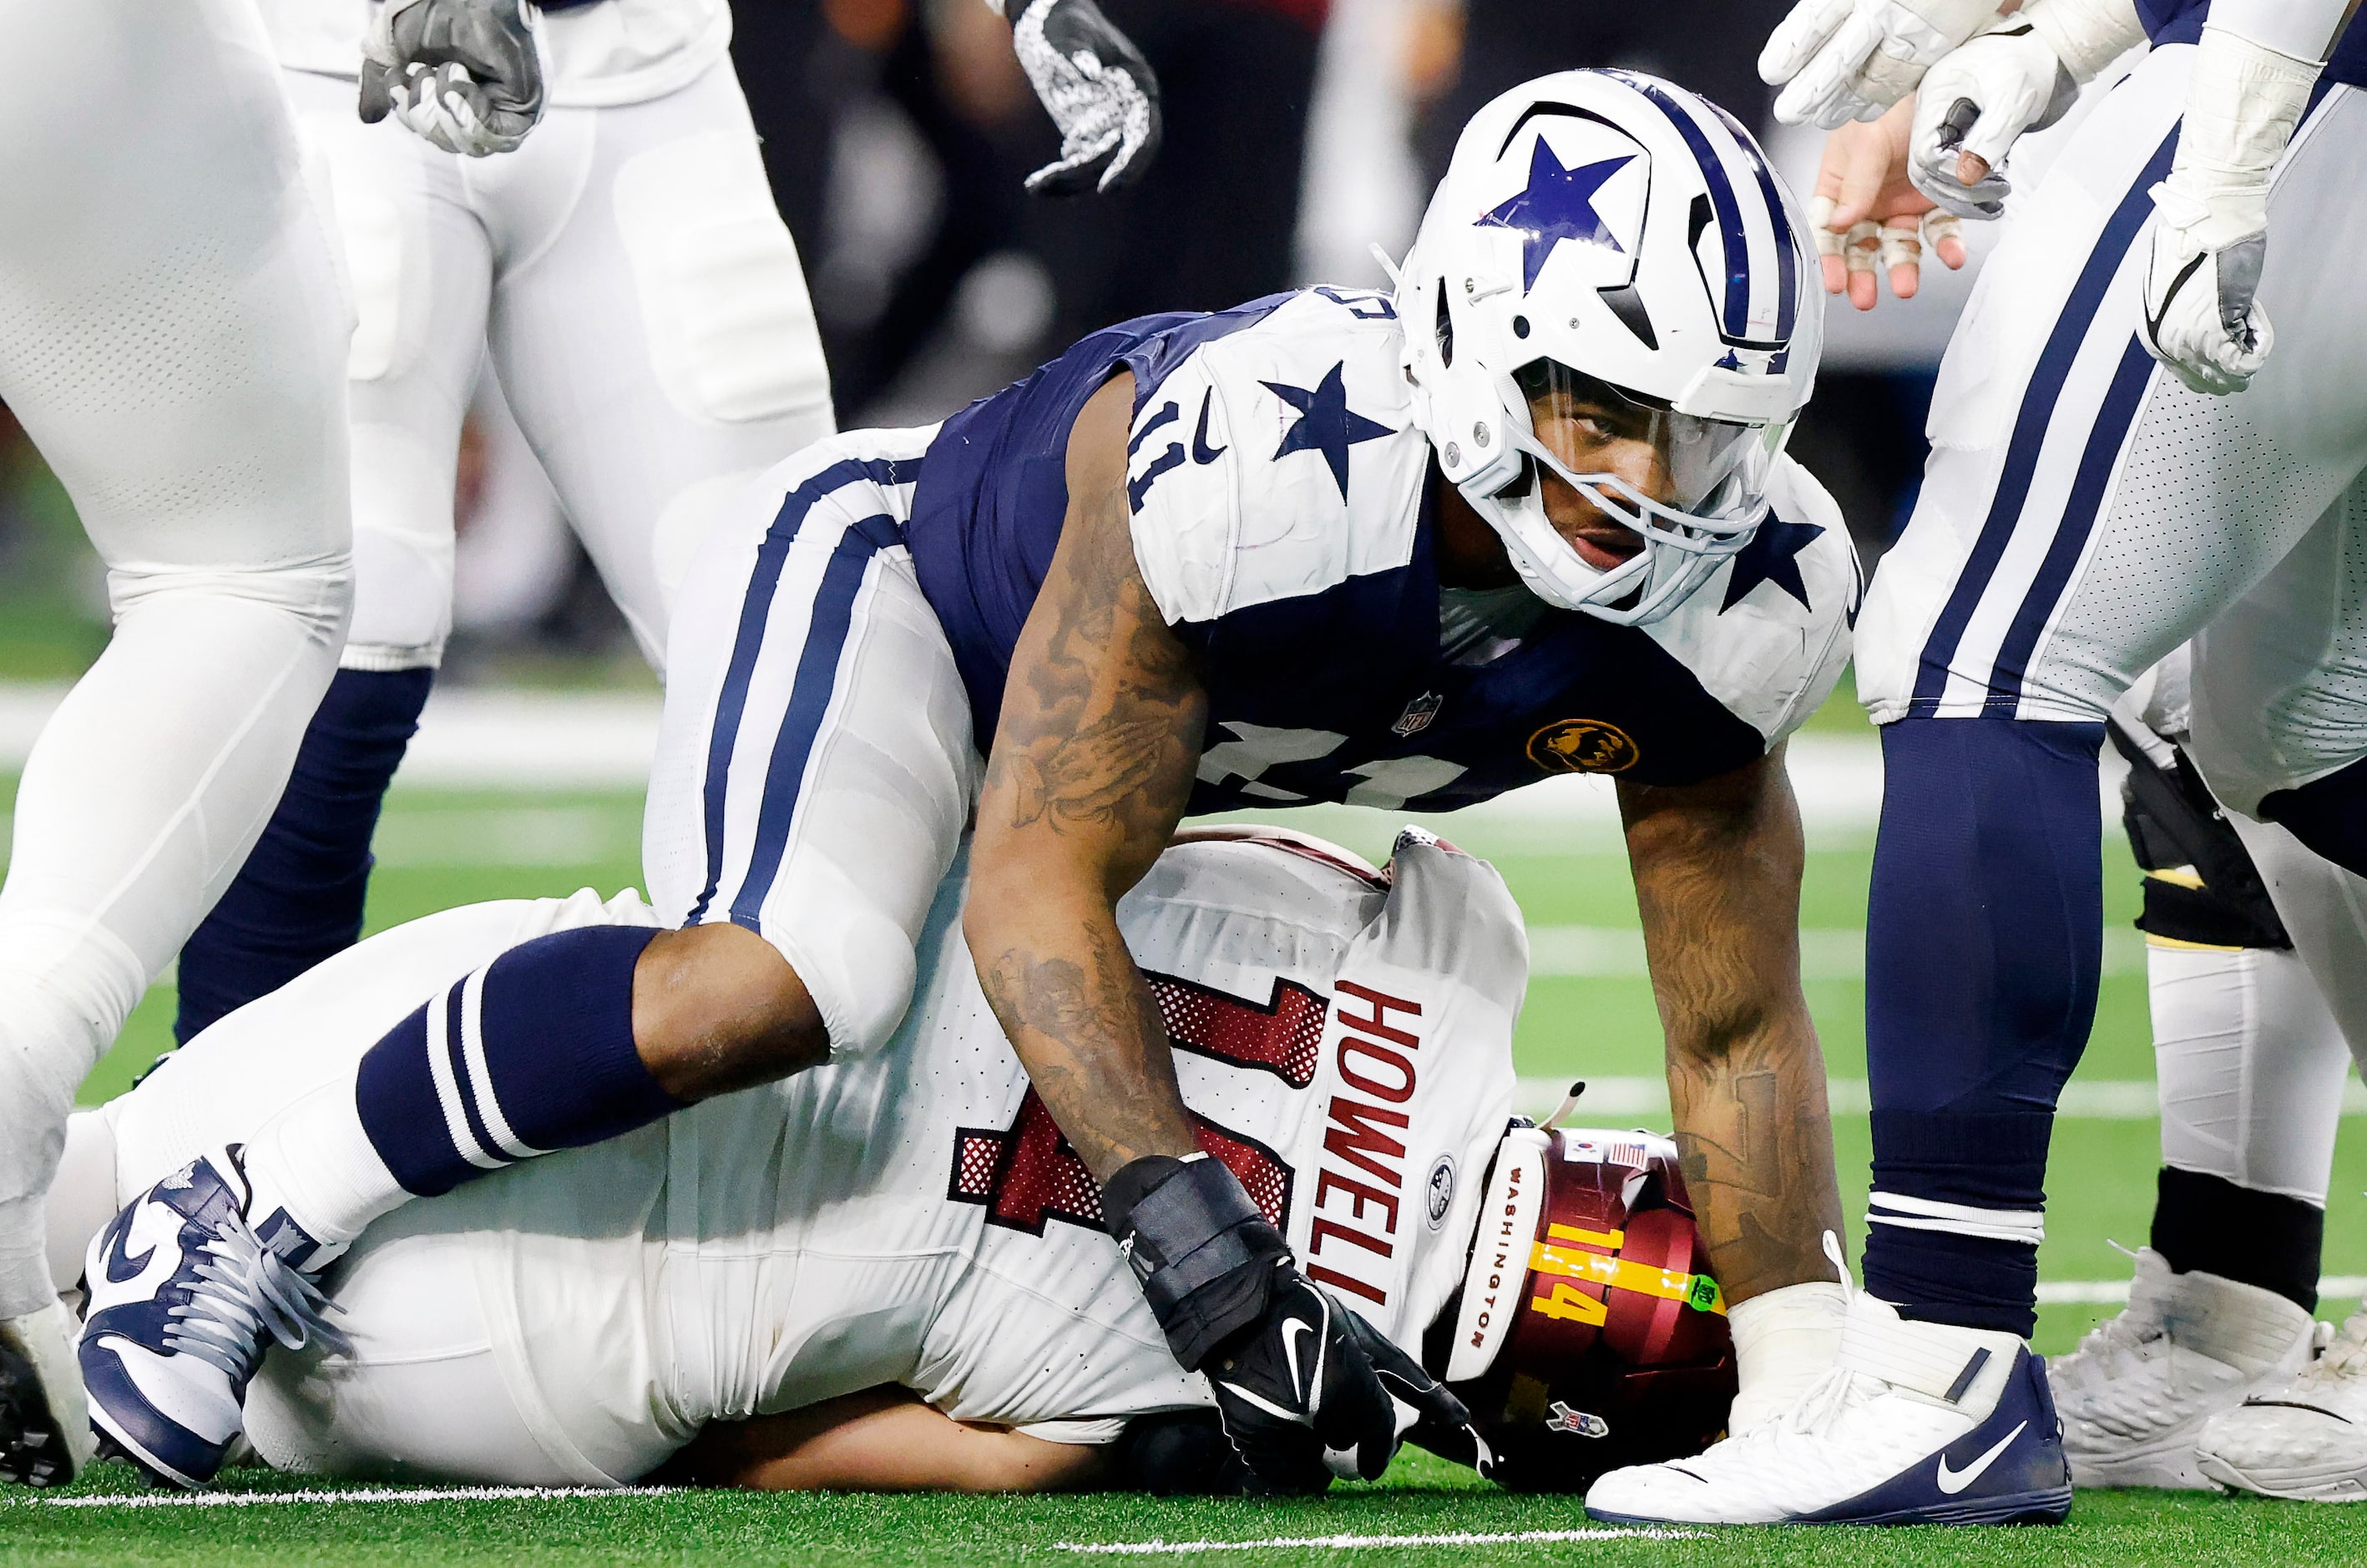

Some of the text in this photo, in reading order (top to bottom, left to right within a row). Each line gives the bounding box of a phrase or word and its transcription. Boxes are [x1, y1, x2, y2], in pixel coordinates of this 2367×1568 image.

[1305, 979, 1423, 1308] HOWELL
[1470, 1166, 1522, 1349] WASHINGTON
[1531, 1222, 1625, 1328] 14
